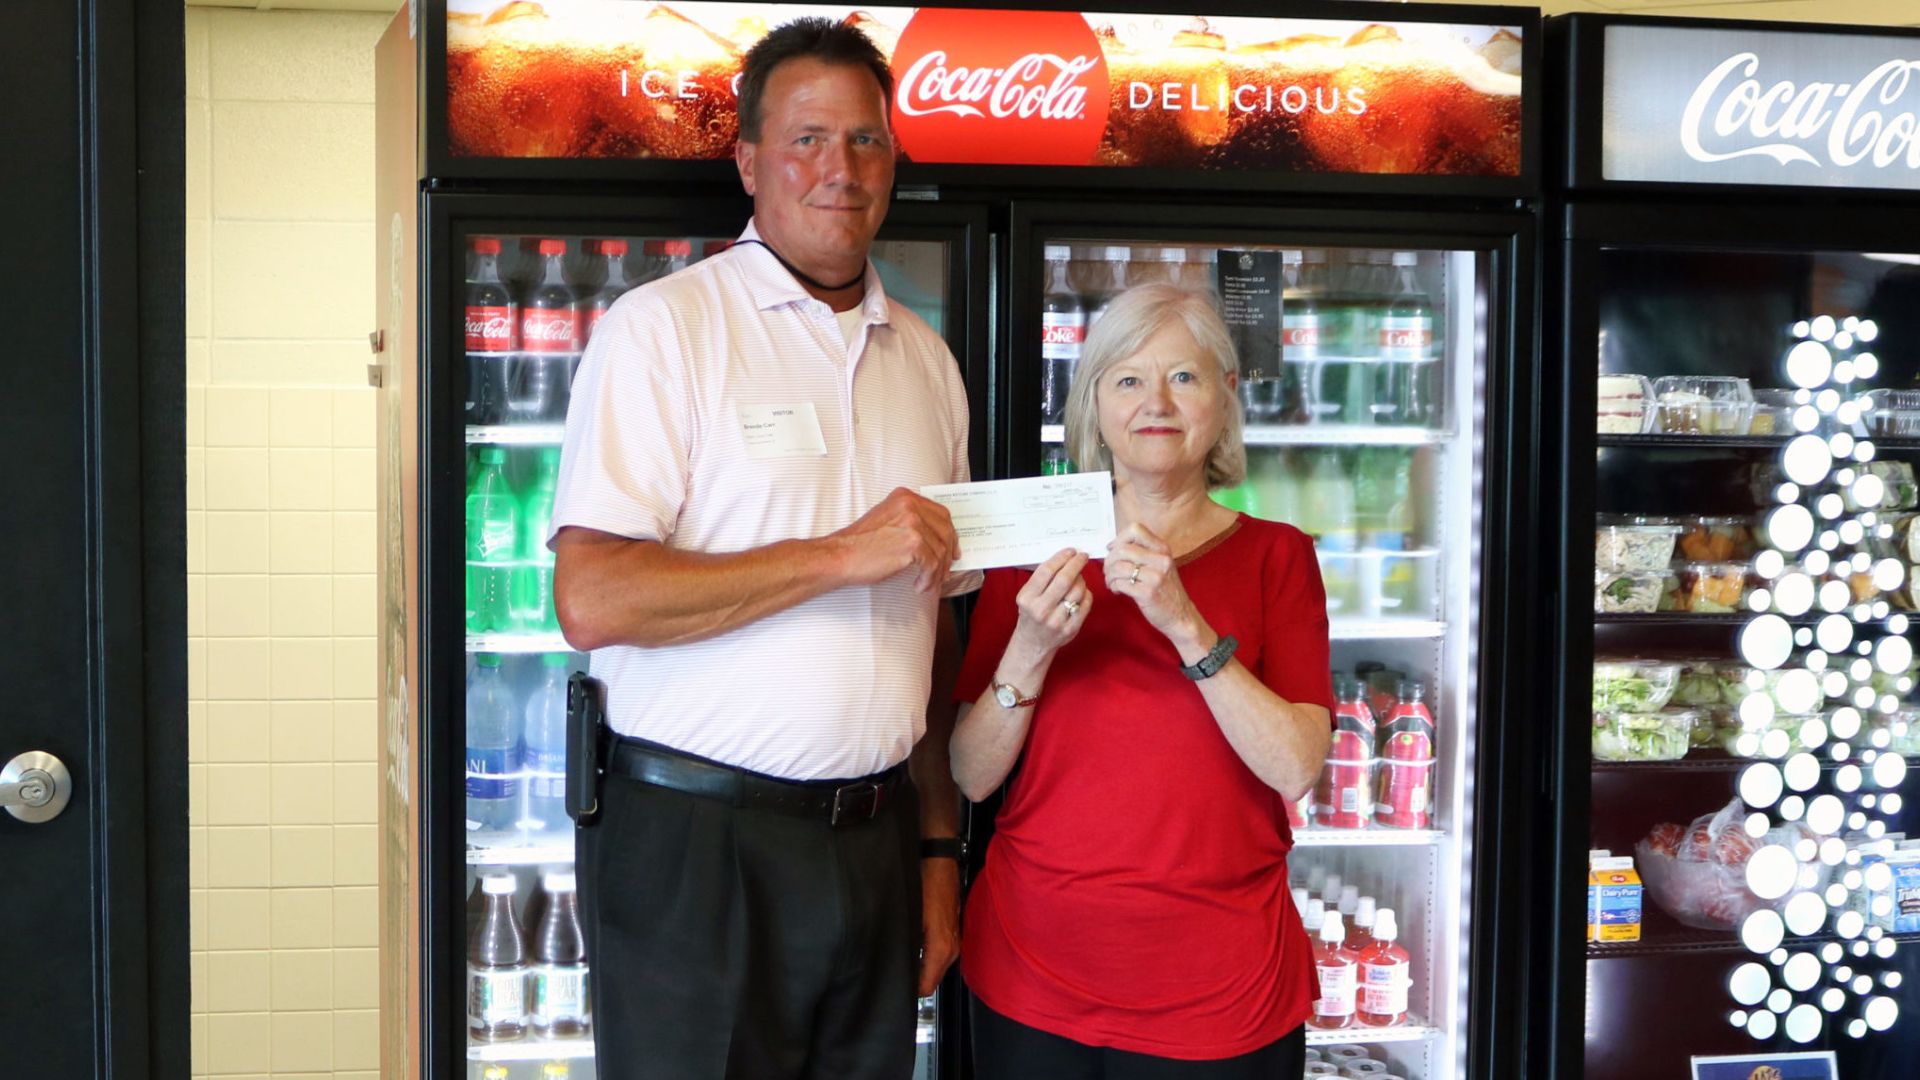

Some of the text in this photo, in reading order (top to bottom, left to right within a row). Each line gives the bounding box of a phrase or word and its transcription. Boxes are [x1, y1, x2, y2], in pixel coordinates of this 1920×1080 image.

[621, 69, 699, 98] ICE
[897, 50, 1099, 120] Coca-Cola
[1129, 81, 1367, 114] DELICIOUS
[1680, 52, 1920, 169] Coca-Co
